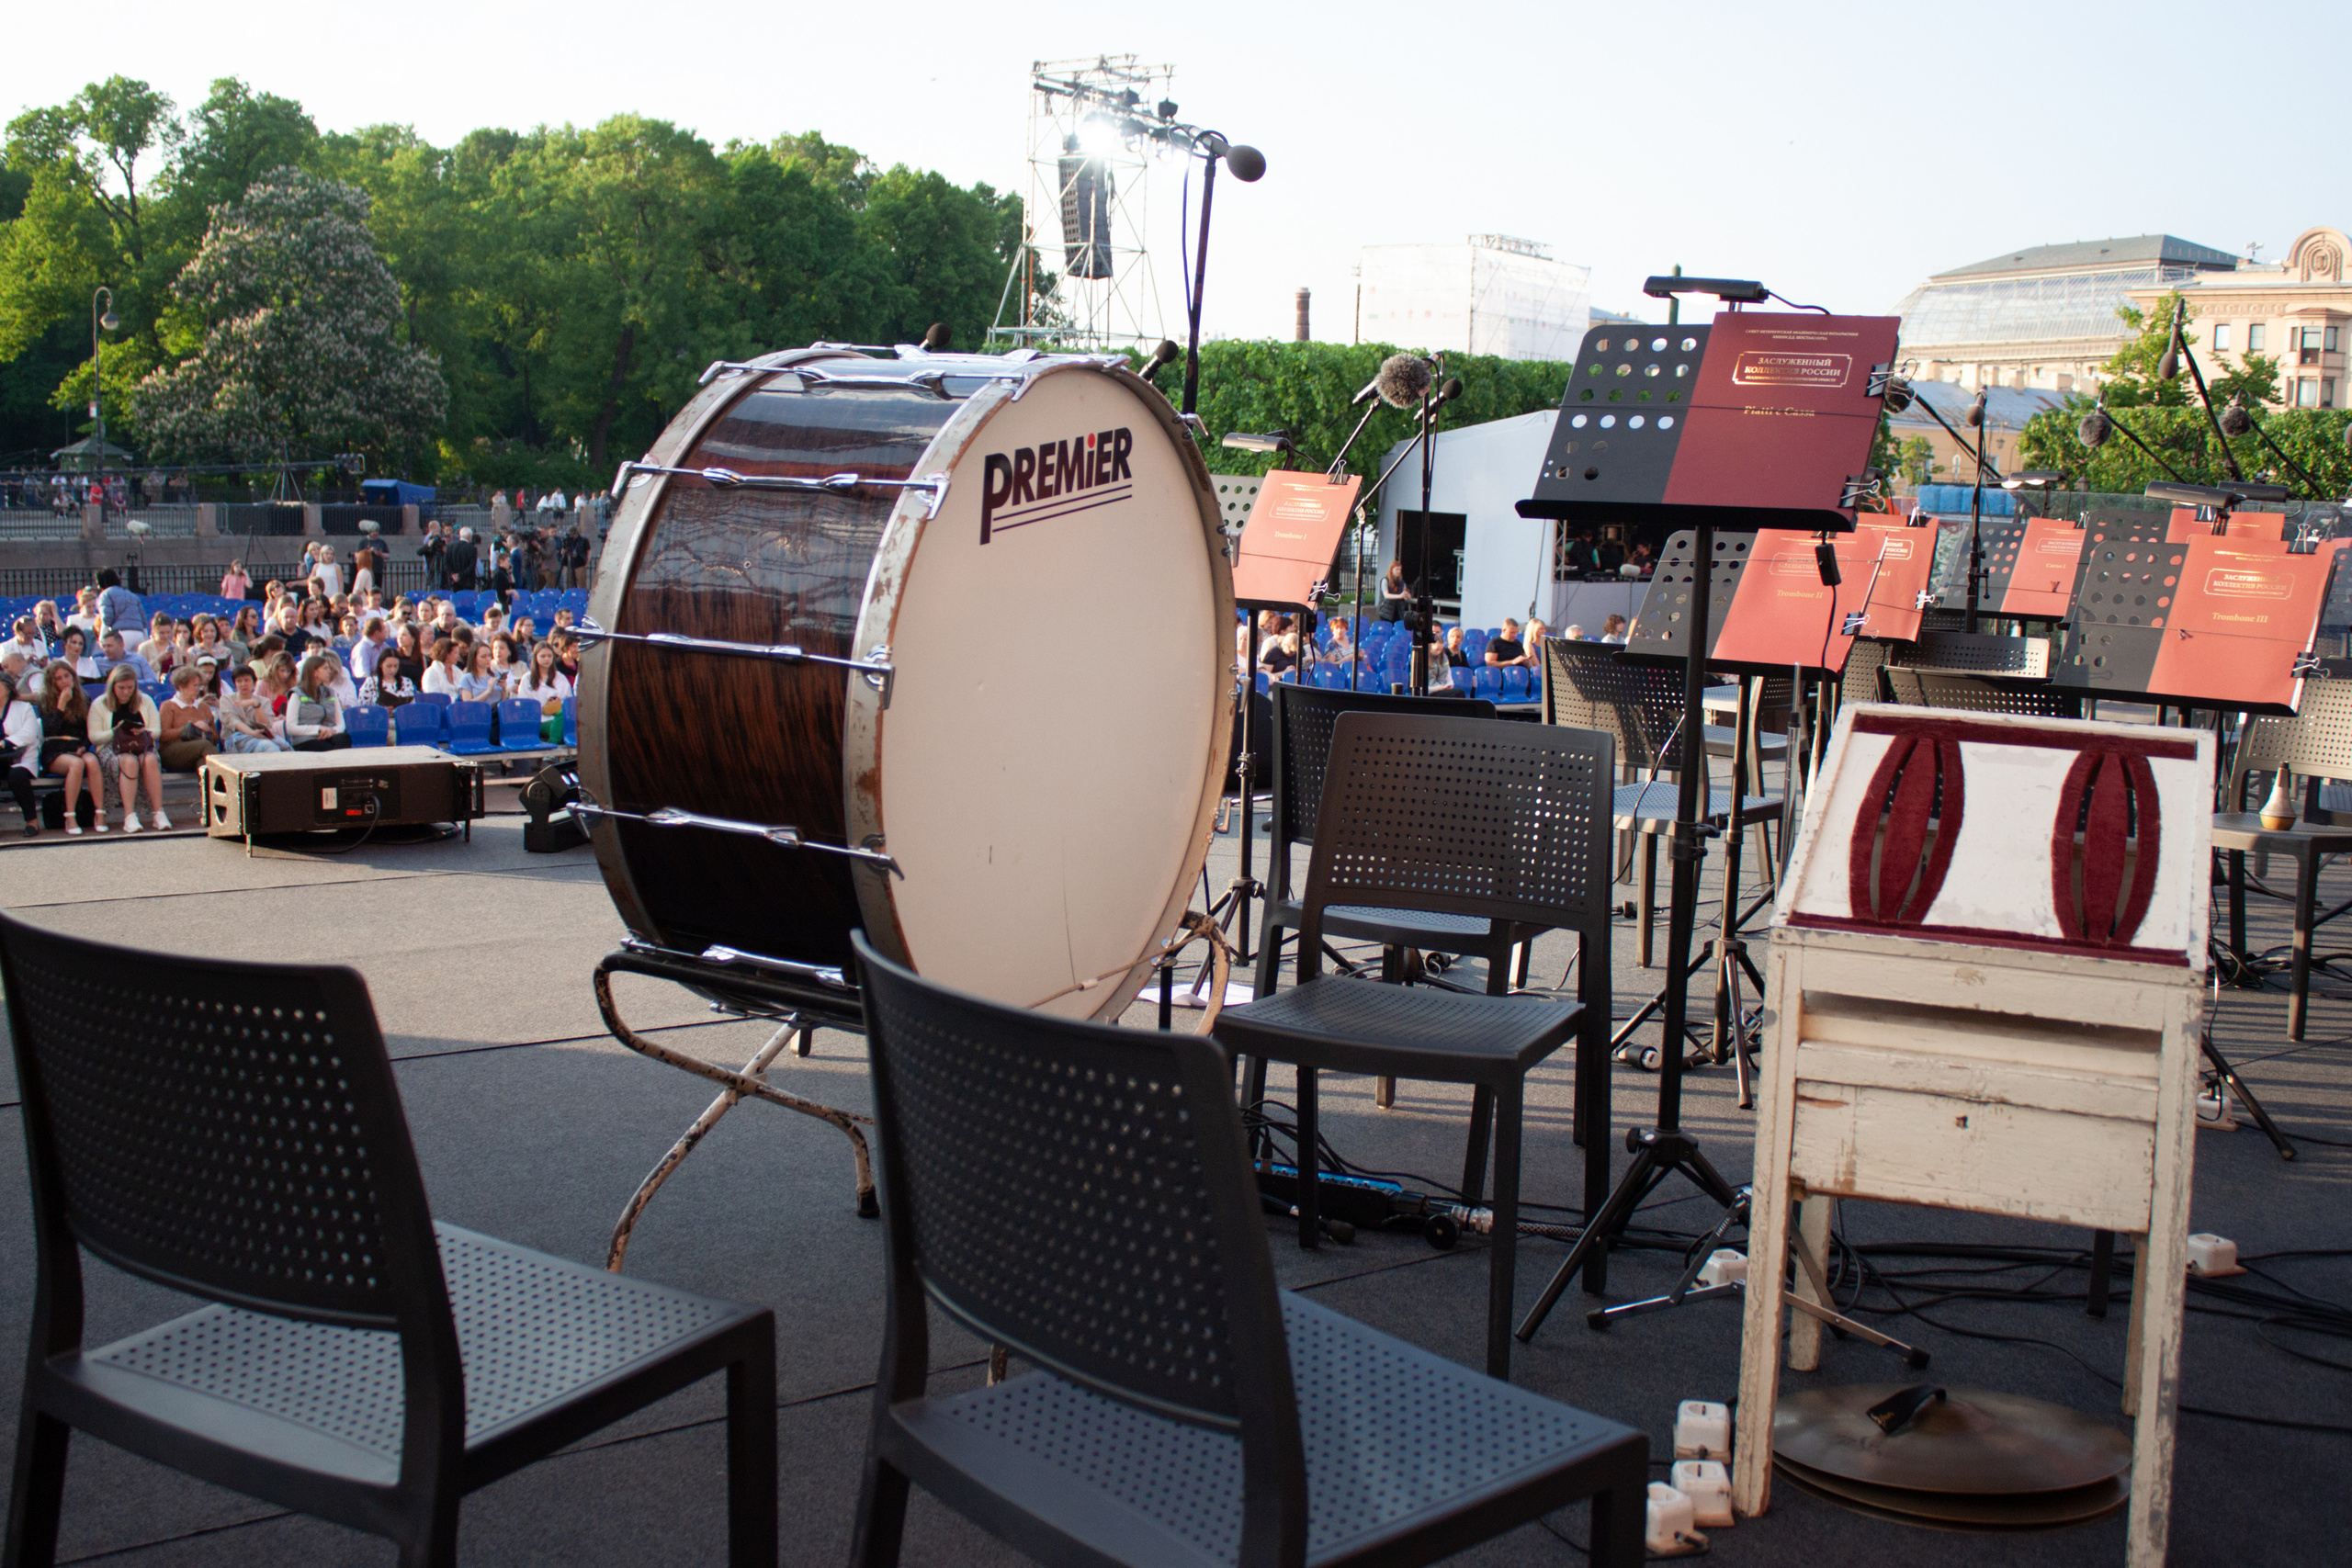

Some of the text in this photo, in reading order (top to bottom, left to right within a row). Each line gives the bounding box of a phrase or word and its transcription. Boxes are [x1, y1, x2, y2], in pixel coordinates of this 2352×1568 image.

[1758, 356, 1832, 367] ЗАСЛУЖЕННЫЙ
[1801, 367, 1841, 377] РОССИИ
[1274, 531, 1303, 539] Trombone
[2212, 581, 2256, 589] КОЛЛЕКТИВ
[1776, 590, 1815, 599] Trombone
[2212, 612, 2268, 623] Trombone III
